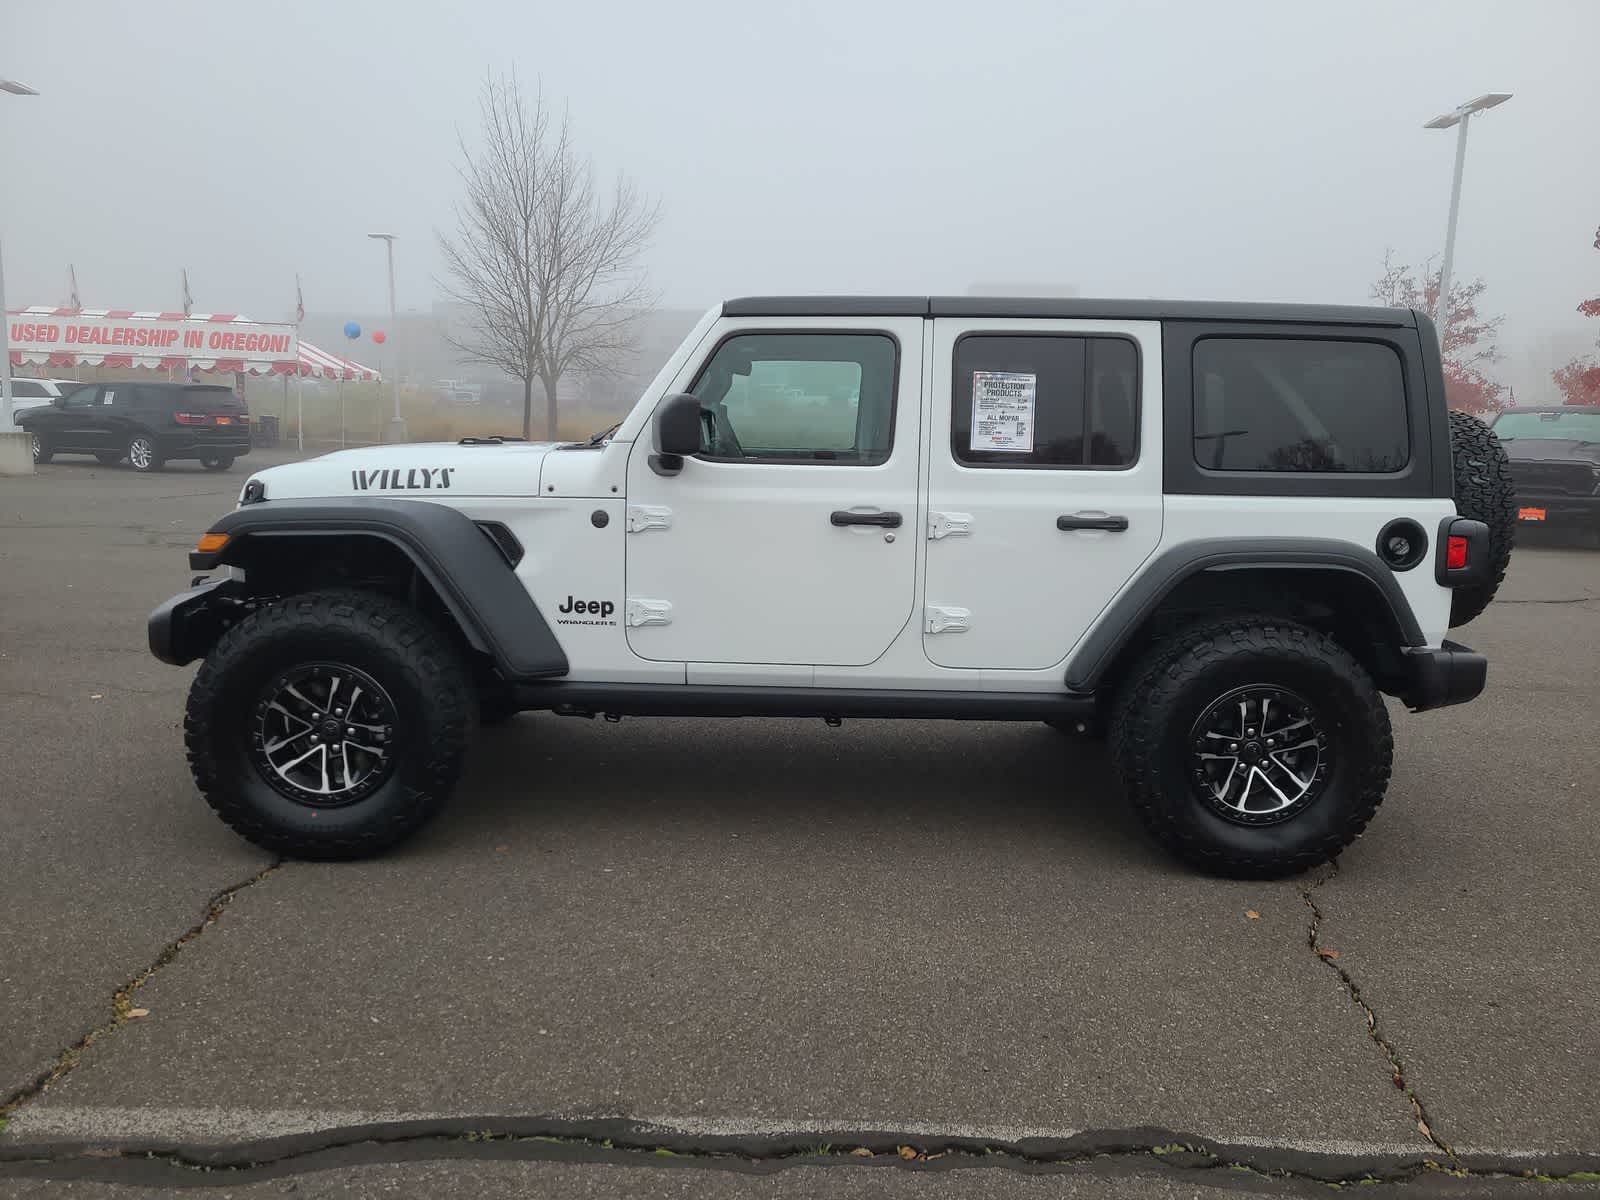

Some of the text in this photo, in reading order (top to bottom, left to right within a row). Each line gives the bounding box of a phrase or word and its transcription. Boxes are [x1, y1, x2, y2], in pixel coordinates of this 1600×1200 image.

[11, 323, 291, 352] USED DEALERSHIP IN OREGON!
[984, 381, 1025, 390] PROTECTION
[986, 389, 1022, 397] PRODUCTS
[351, 468, 455, 490] WILLYS
[559, 595, 614, 618] Jeep
